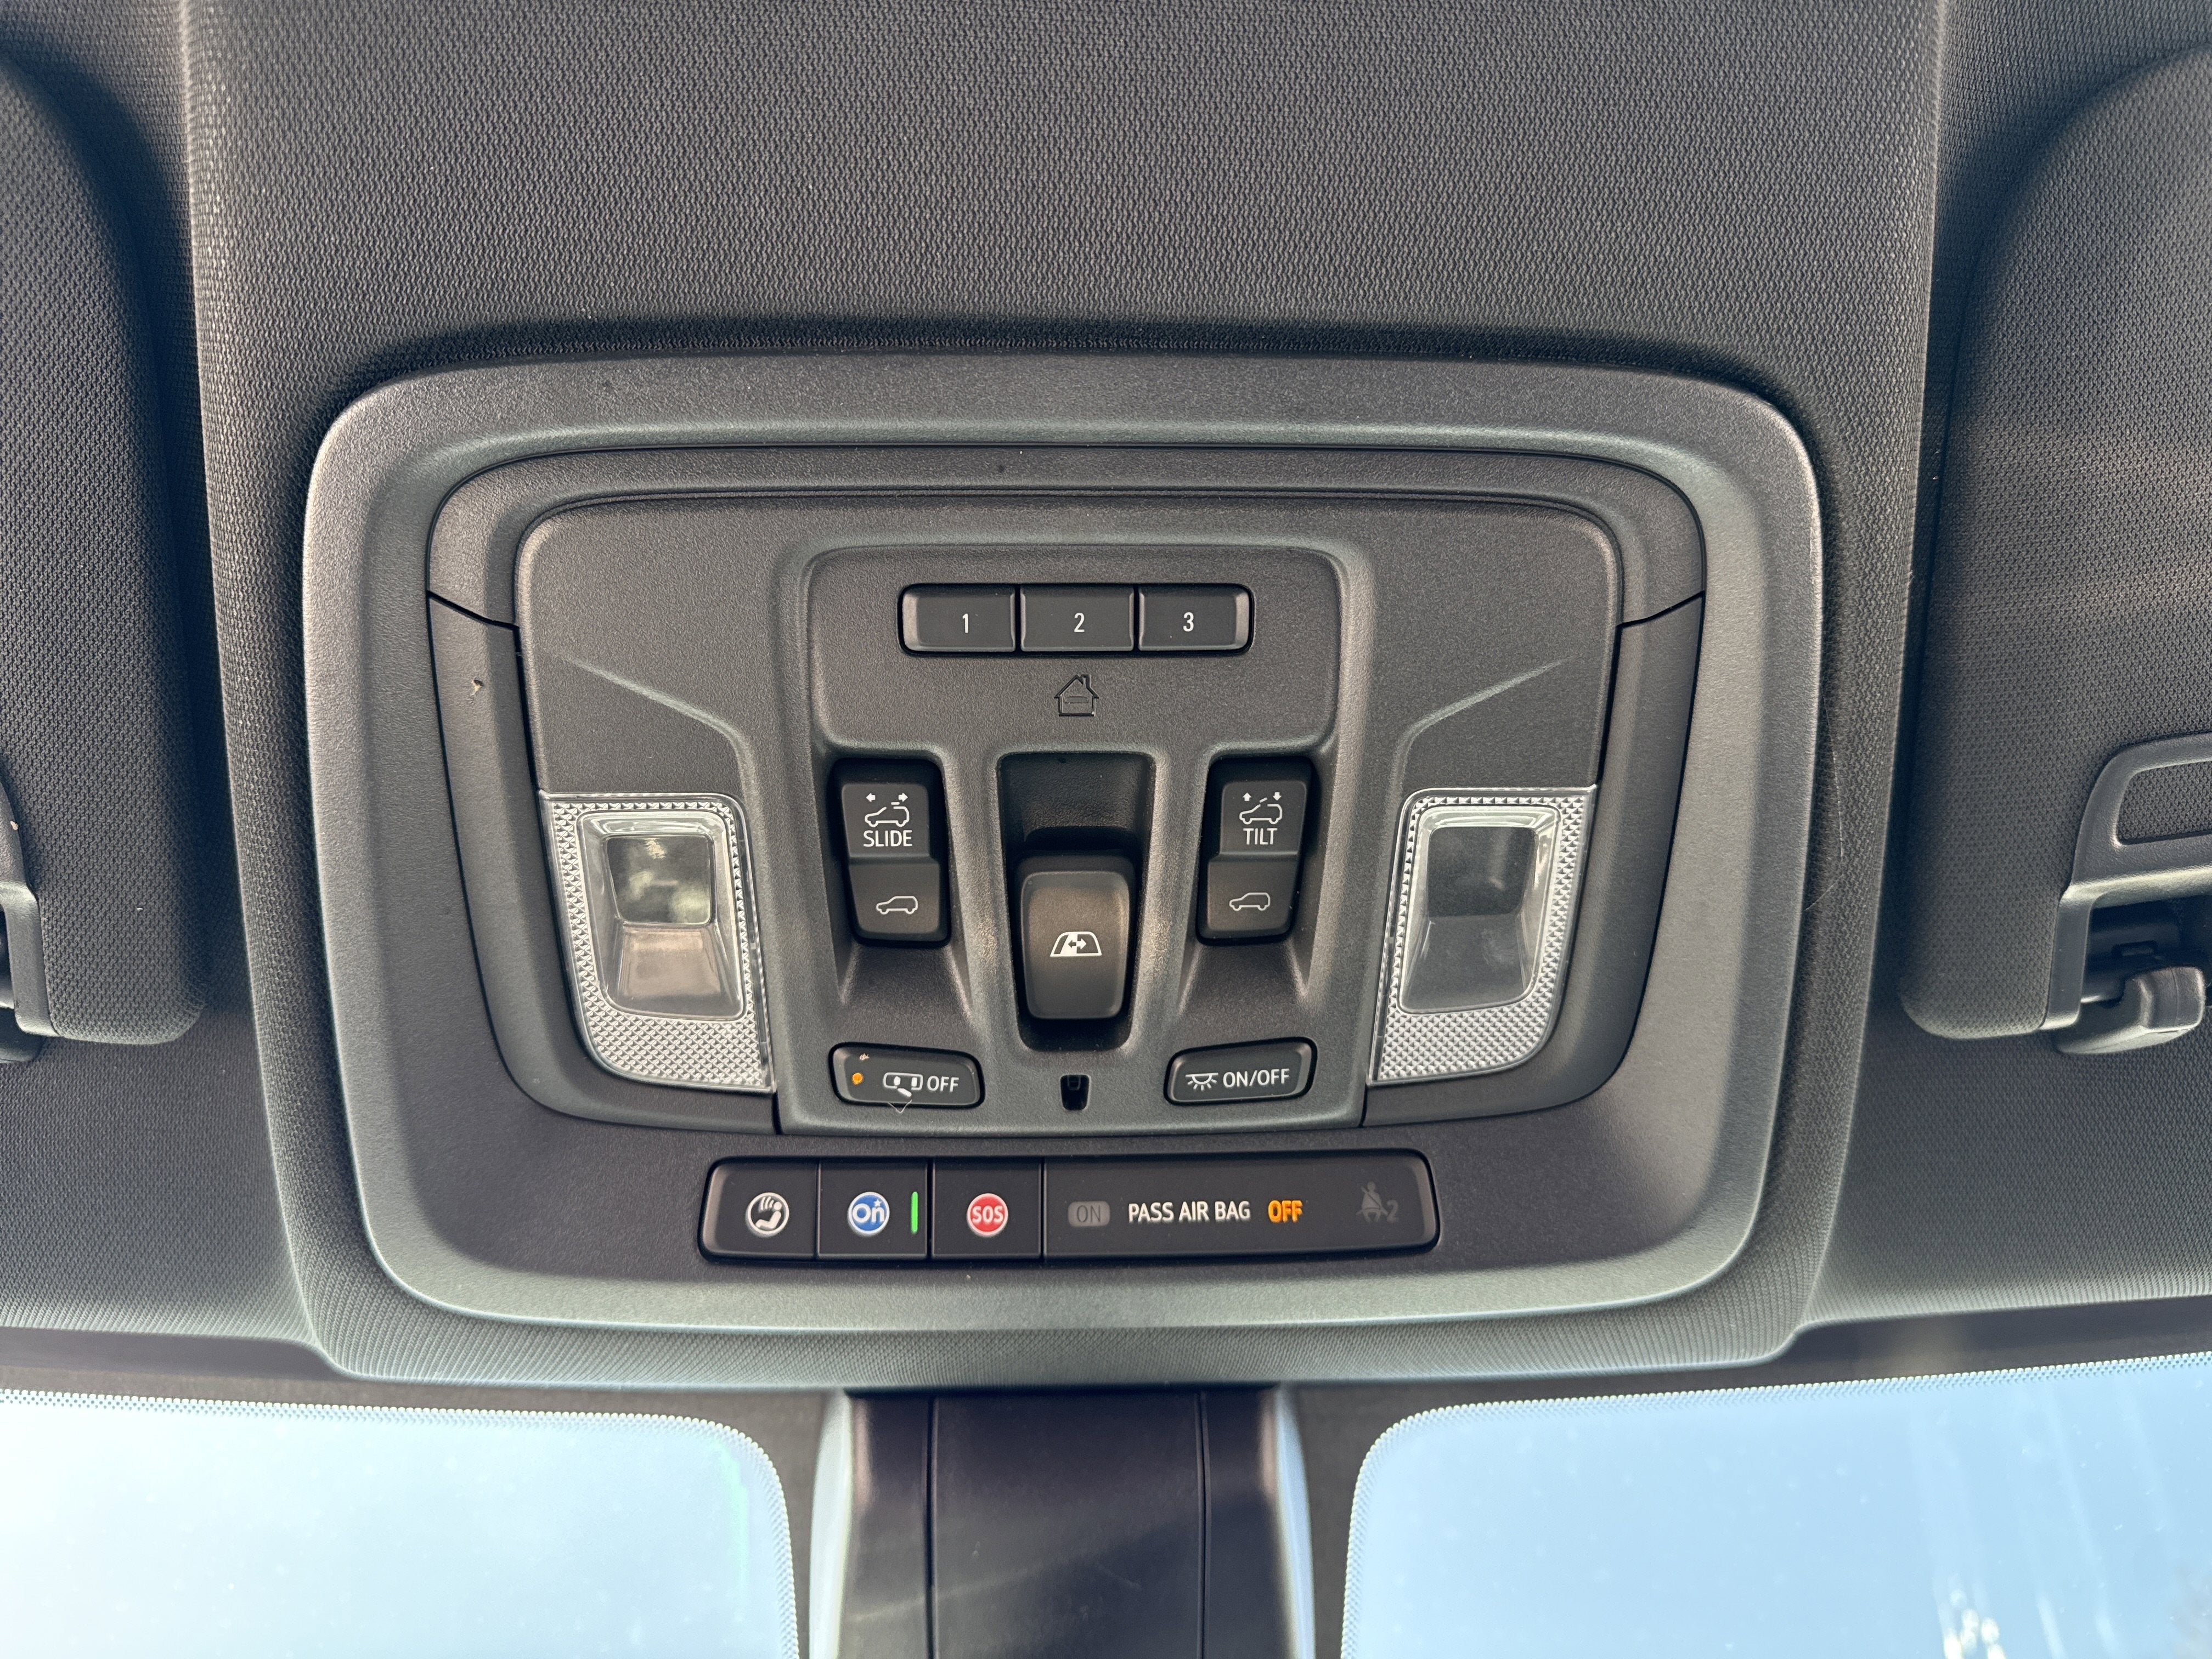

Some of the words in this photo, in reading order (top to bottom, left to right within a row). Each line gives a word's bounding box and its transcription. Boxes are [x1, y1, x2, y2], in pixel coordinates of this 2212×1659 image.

[962, 613, 969, 634] 1
[1074, 612, 1085, 633] 2
[1182, 612, 1194, 632] 3
[863, 830, 913, 847] SLIDE
[1243, 828, 1278, 845] TILT
[927, 1075, 960, 1093] OFF
[1222, 1068, 1290, 1088] ON/OFF
[971, 1205, 1004, 1223] SOS
[1076, 1204, 1102, 1223] ON
[1128, 1201, 1173, 1223] PASS
[1178, 1201, 1209, 1222] AIR
[1215, 1200, 1251, 1222] BAG
[1267, 1199, 1304, 1223] OFF
[1386, 1199, 1398, 1223] 2
